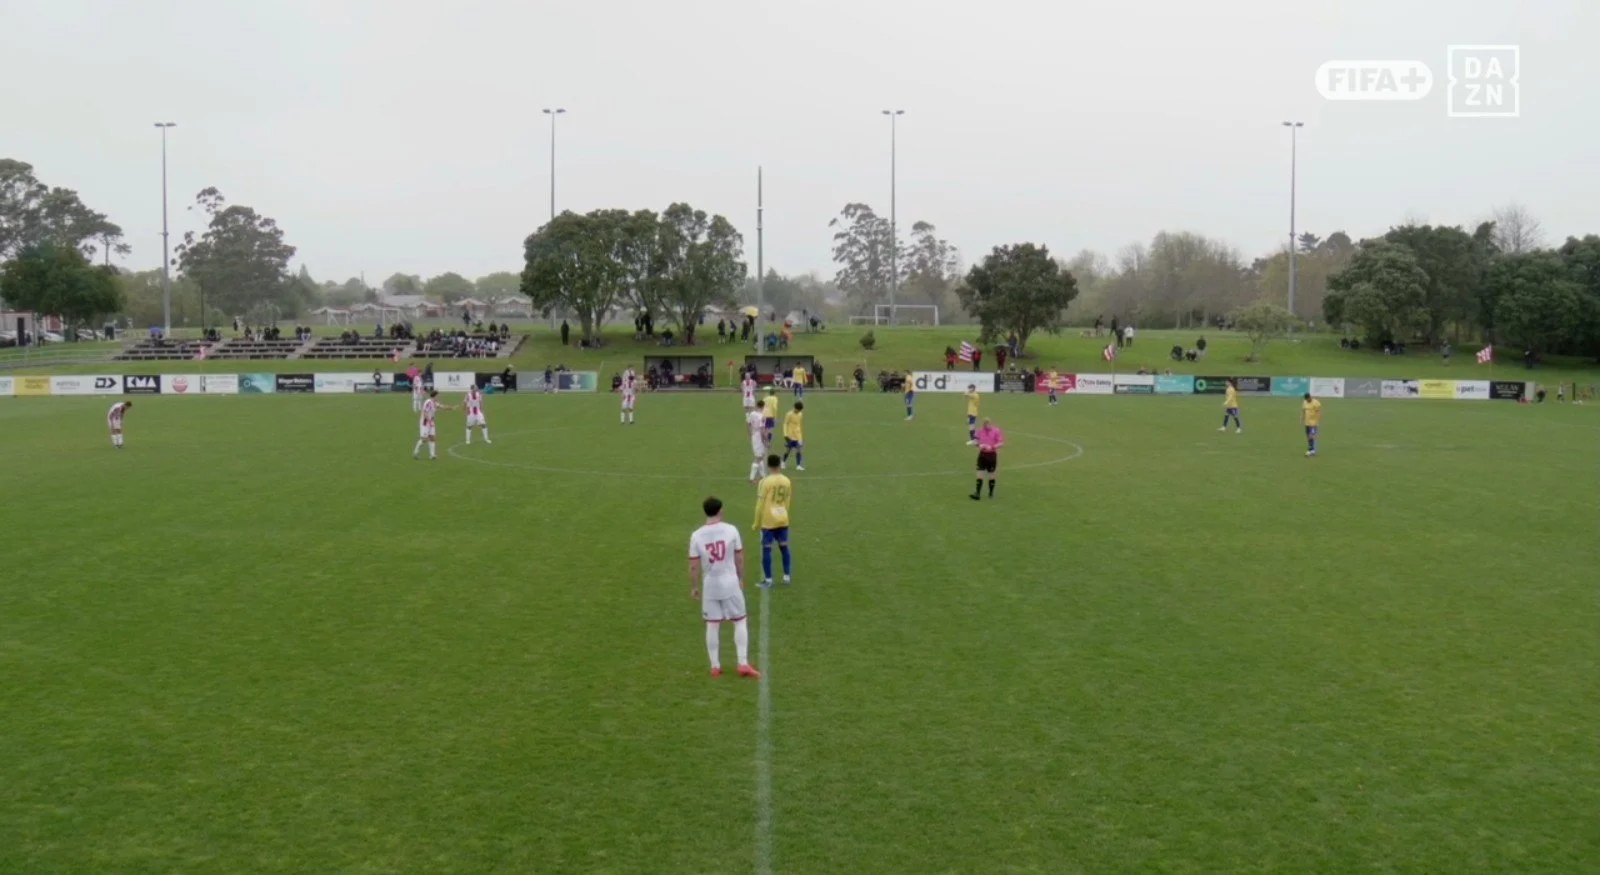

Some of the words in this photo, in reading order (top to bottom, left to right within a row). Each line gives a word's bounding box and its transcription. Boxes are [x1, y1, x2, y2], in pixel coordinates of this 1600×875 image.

[126, 376, 157, 388] KMA
[771, 484, 786, 504] 19
[705, 540, 726, 564] 30
